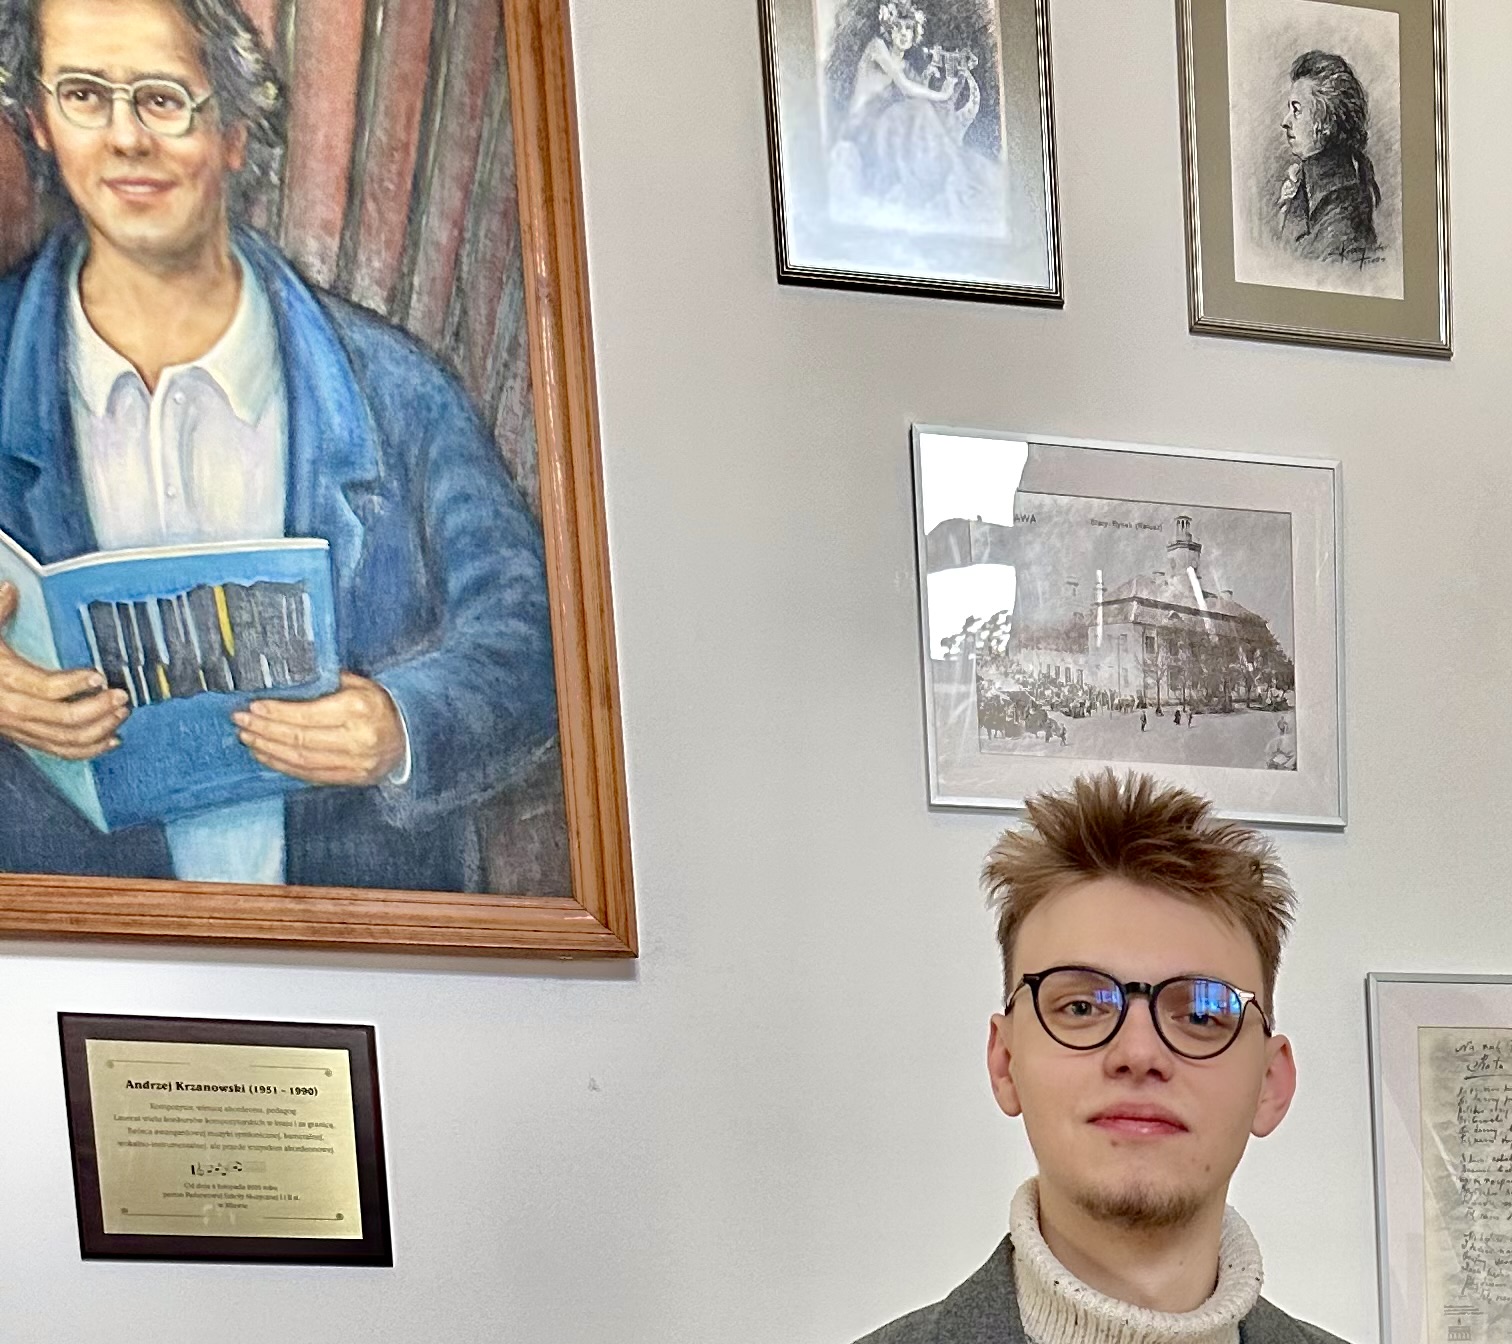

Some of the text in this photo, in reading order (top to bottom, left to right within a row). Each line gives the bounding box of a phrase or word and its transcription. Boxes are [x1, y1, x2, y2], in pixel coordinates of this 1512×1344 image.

[126, 1079, 172, 1093] Andrzej
[176, 1081, 246, 1094] Krzanowski
[249, 1084, 278, 1095] (1951
